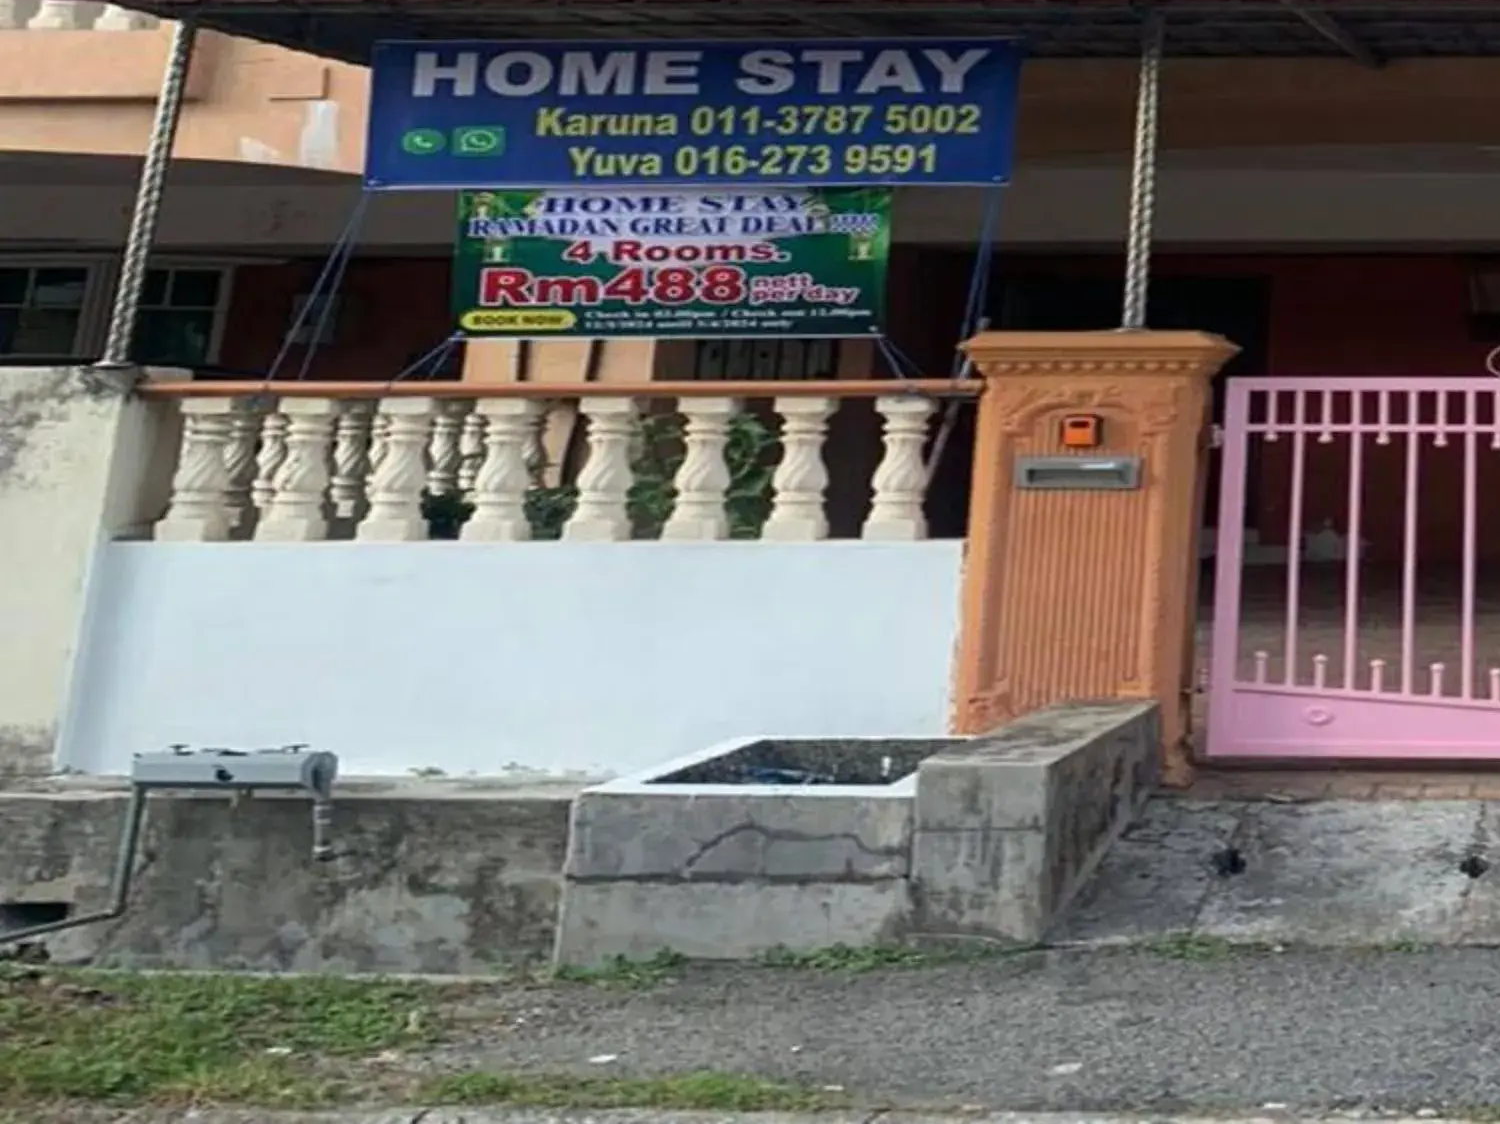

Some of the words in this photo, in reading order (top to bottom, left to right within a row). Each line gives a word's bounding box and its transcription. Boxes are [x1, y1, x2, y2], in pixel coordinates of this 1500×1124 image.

[412, 51, 703, 97] HOME
[736, 49, 990, 95] STAY
[535, 107, 678, 137] Karuna
[691, 105, 873, 135] 011-3787
[884, 104, 980, 134] 5002
[569, 146, 662, 176] Yuva
[675, 144, 831, 175] 016-273
[845, 143, 936, 173] 9591
[543, 196, 685, 214] HOME
[700, 195, 801, 212] STAY
[470, 218, 620, 237] RAMADAN
[630, 217, 729, 236] GREAT
[564, 240, 593, 262] 4
[482, 267, 746, 305] Rm488
[803, 285, 860, 304] day
